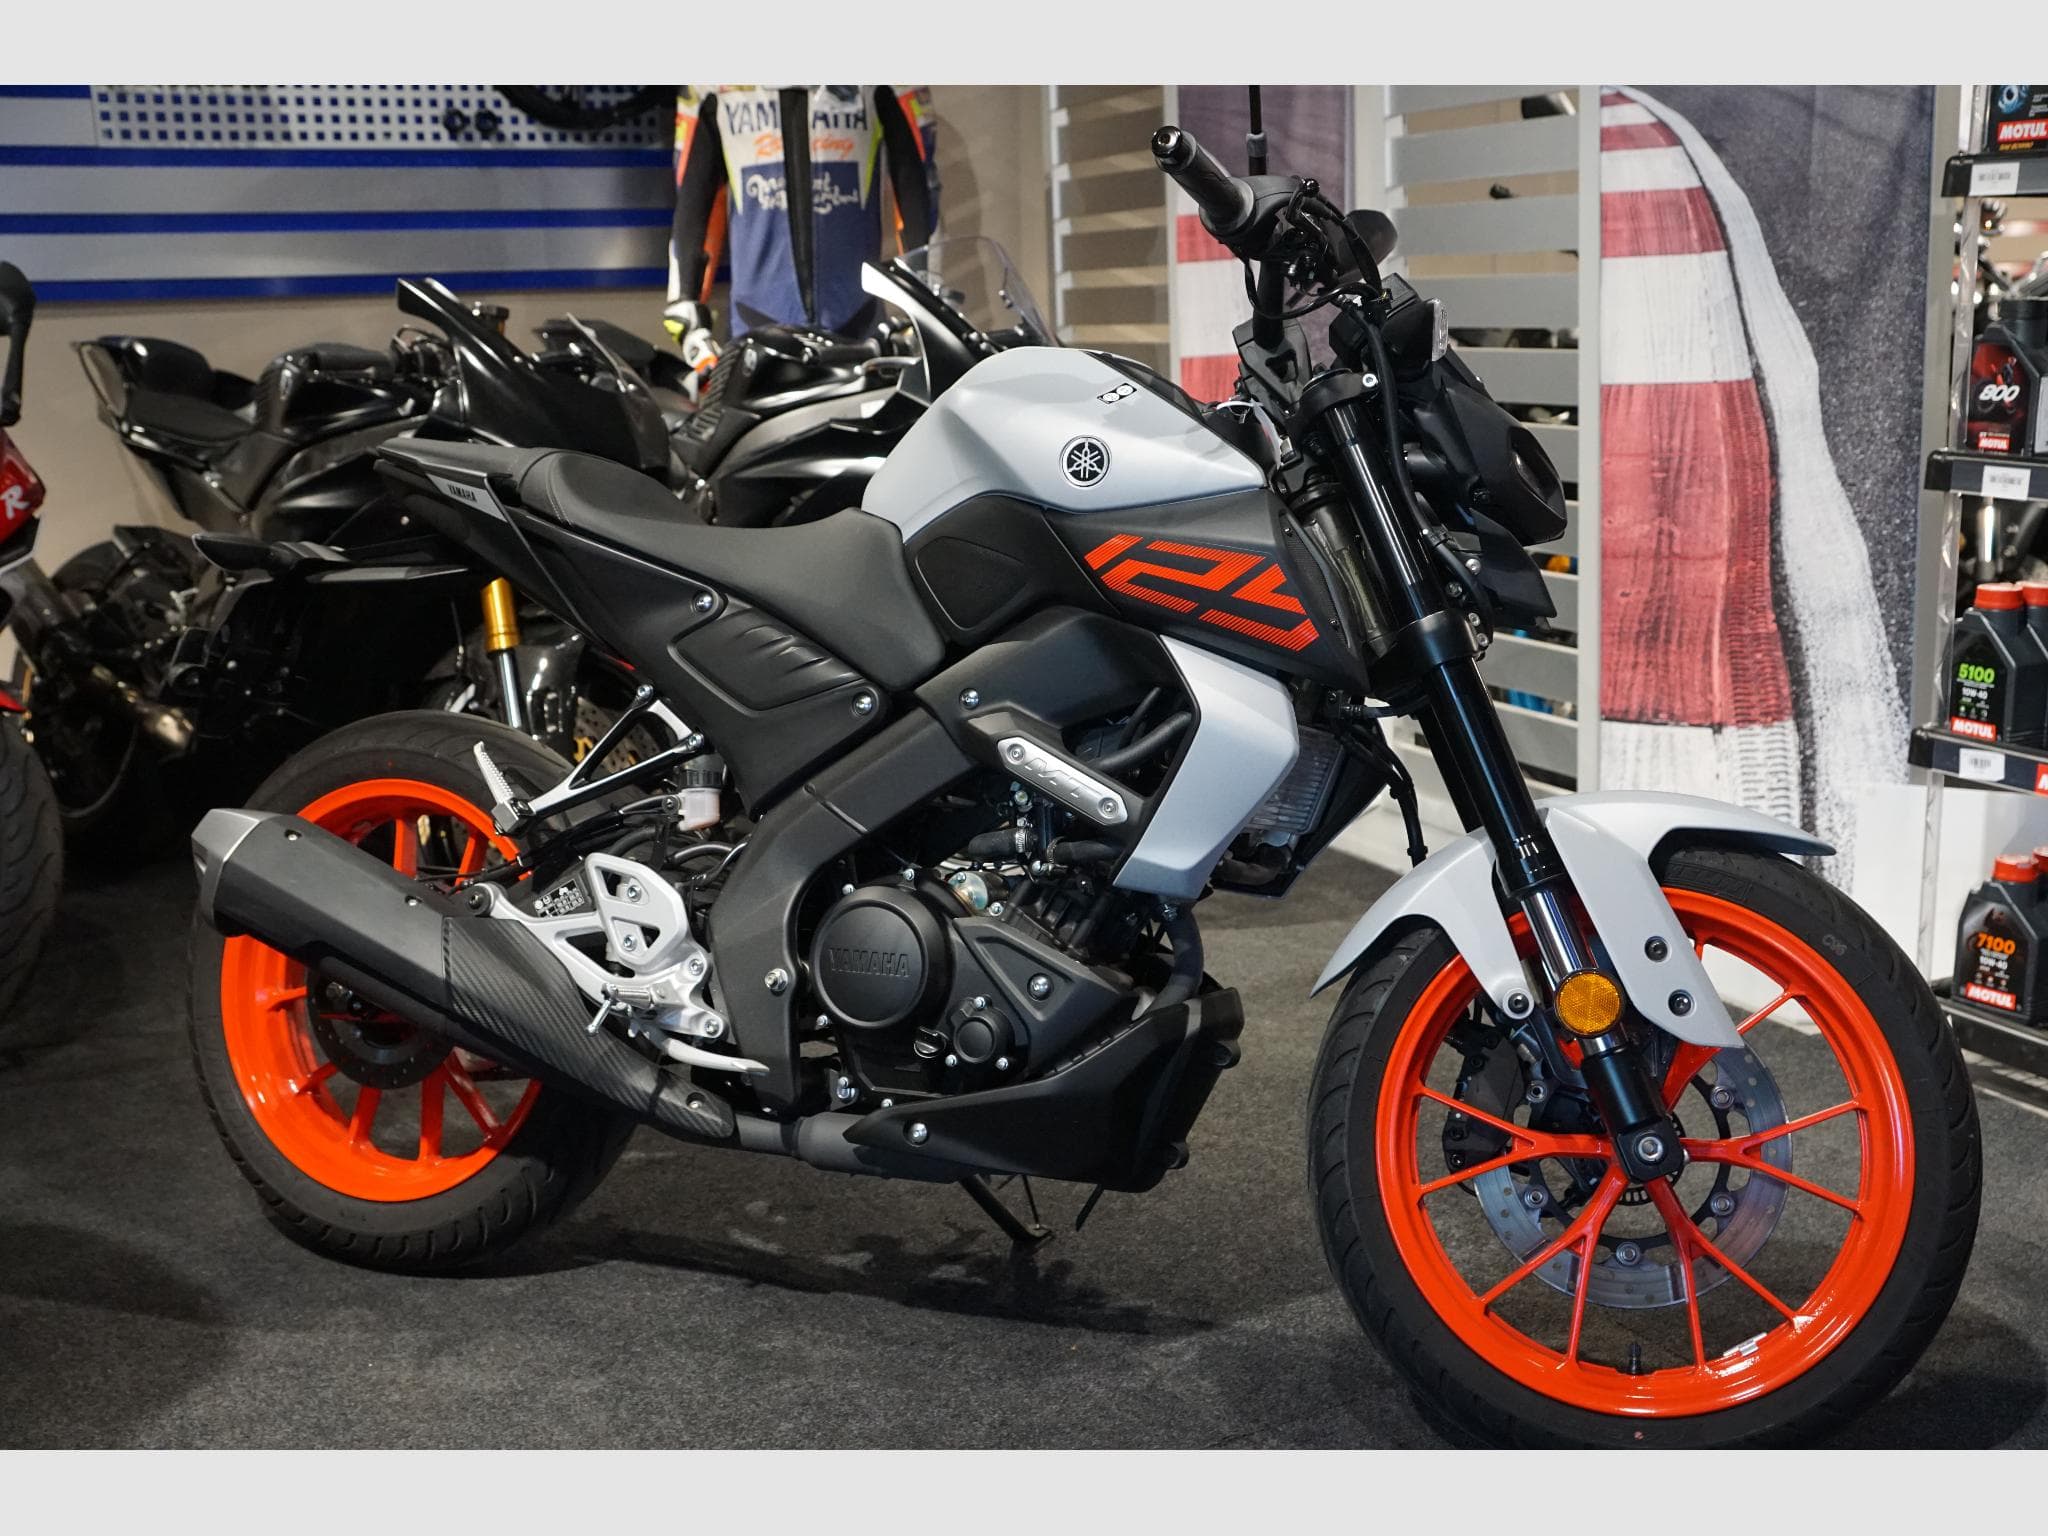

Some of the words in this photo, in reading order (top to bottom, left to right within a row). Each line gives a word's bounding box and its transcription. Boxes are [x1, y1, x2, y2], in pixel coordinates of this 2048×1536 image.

[2000, 122, 2048, 140] MOTUL
[1979, 384, 2020, 402] 800
[1980, 437, 2008, 450] MOTUL
[447, 484, 478, 502] YAMAHA
[1958, 663, 1995, 683] 5100
[1962, 686, 1988, 700] 10W-40
[1952, 718, 1994, 739] MOTUL
[1976, 931, 2016, 955] 7100
[829, 947, 911, 977] YAMAHA
[1967, 984, 2013, 1008] MOTUL
